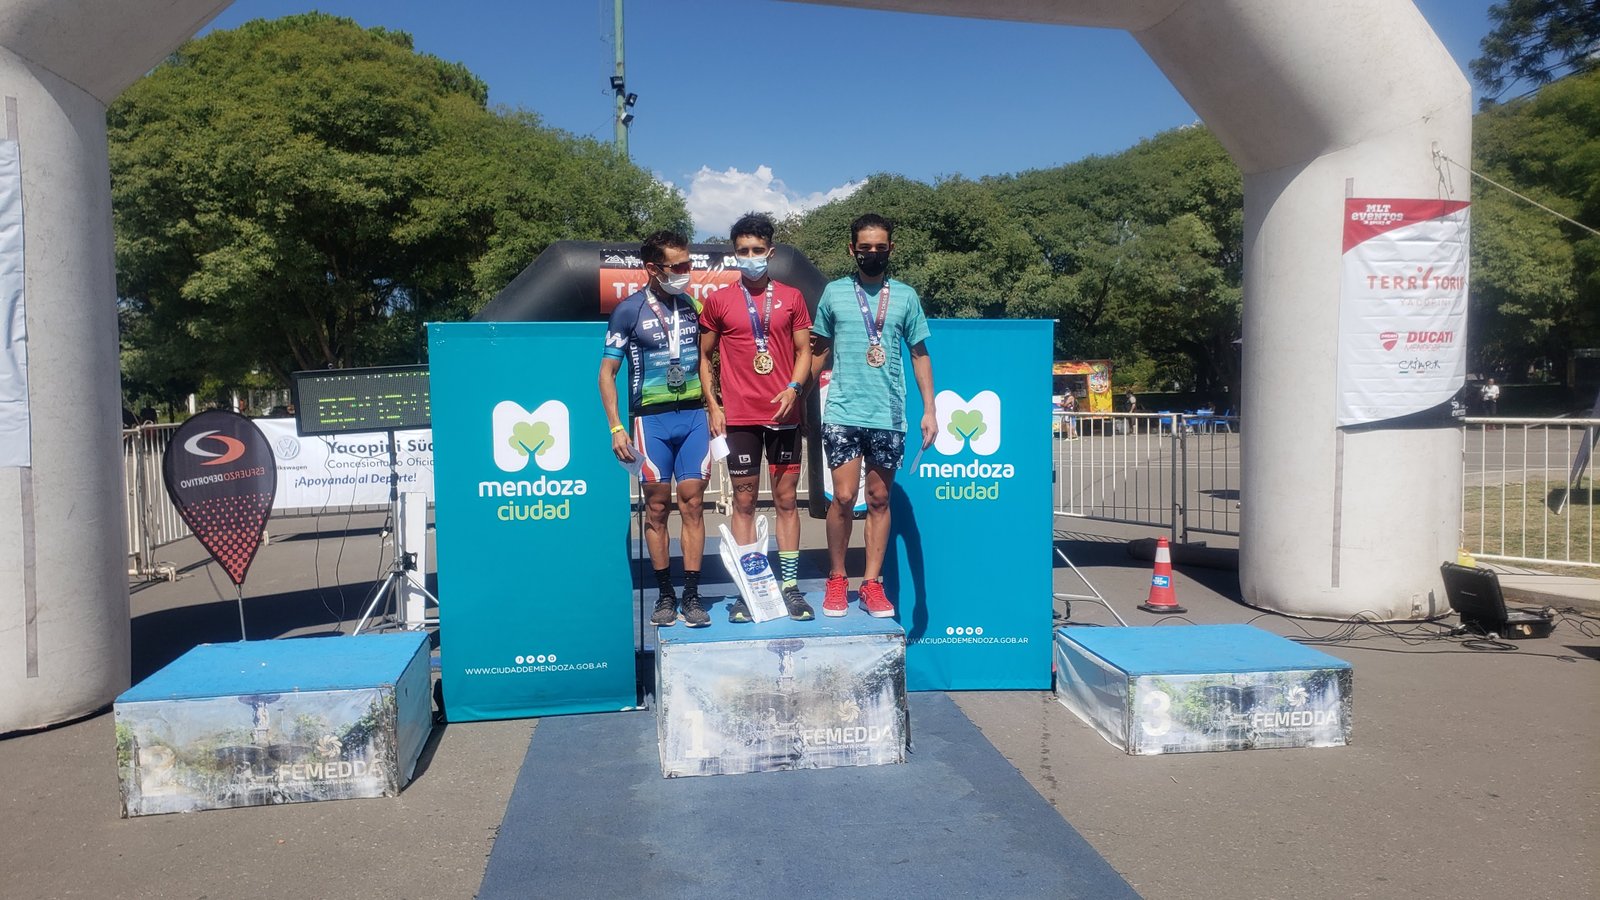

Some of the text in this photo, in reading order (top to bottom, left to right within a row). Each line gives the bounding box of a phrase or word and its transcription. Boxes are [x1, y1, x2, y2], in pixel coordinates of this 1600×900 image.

[1366, 204, 1391, 212] MLT
[653, 325, 696, 341] SHANO
[1406, 331, 1453, 343] DUCATI
[659, 337, 694, 348] HAD
[327, 457, 434, 469] Concesionao Ofici
[919, 459, 1015, 478] mendoza
[294, 473, 417, 488] ¡Apoyando al Deprte!
[478, 475, 588, 498] mendoza
[935, 481, 999, 500] ciudad
[497, 499, 570, 521] ciudad
[465, 662, 608, 675] WWW.CIUDADDEMENDOZA.GOB.AR
[1141, 690, 1171, 737] 3
[1254, 710, 1338, 728] FEMEDDA
[684, 710, 709, 758] 1
[803, 724, 895, 746] FEMEDDA
[279, 760, 385, 782] FEMEDDA
